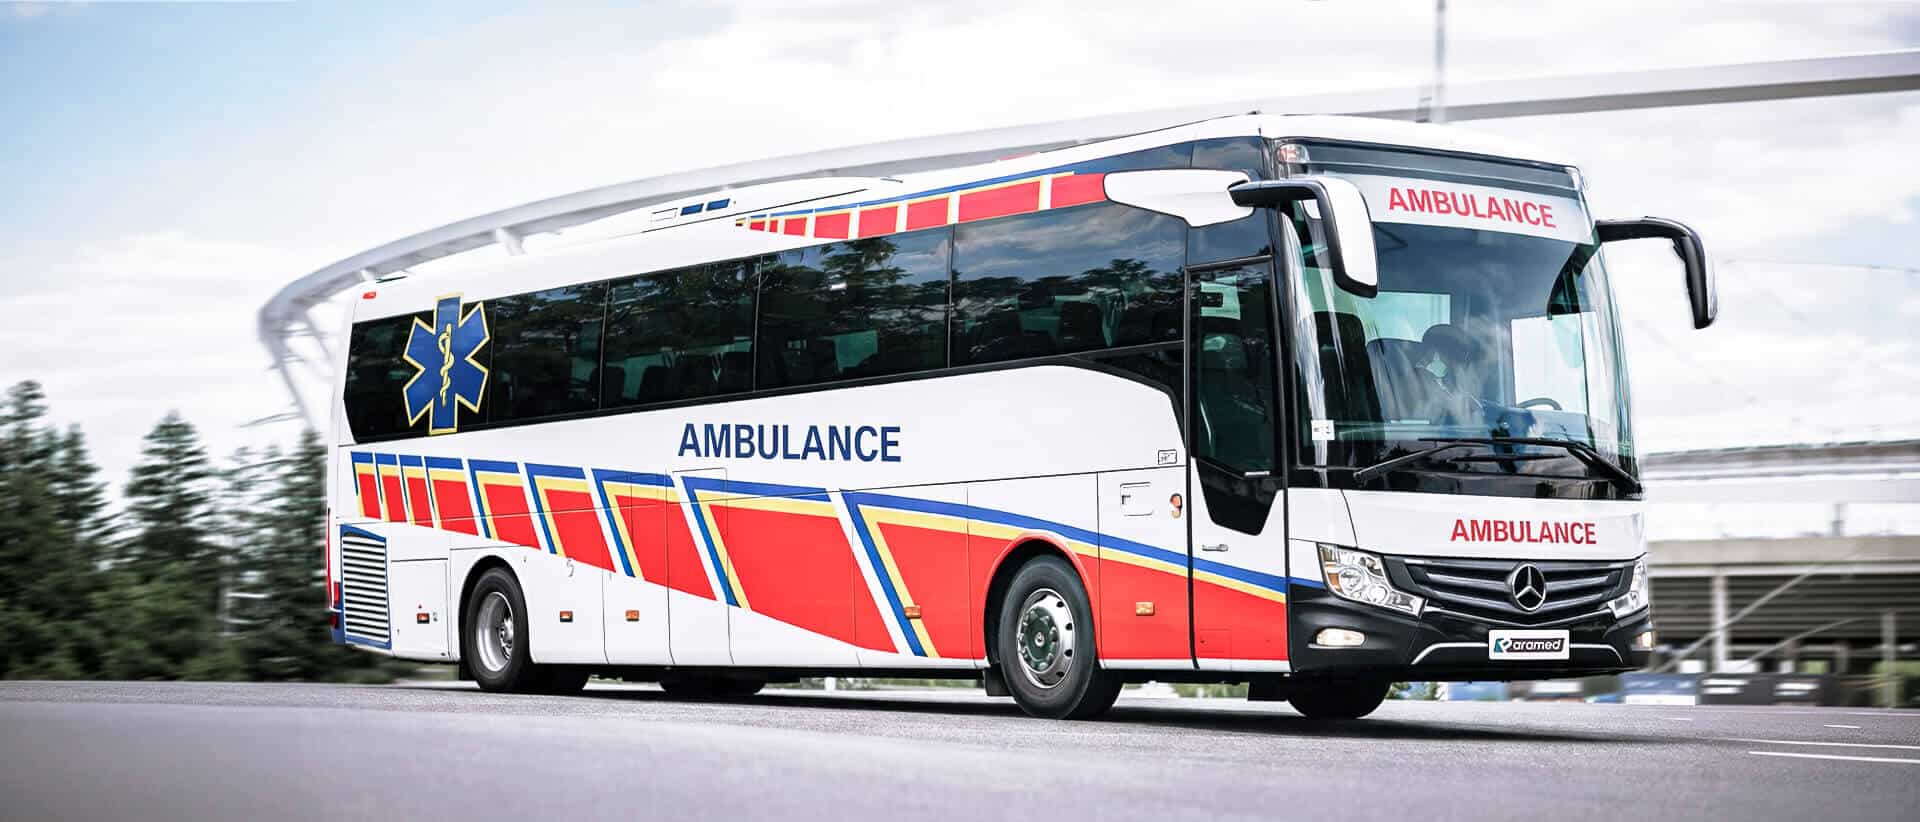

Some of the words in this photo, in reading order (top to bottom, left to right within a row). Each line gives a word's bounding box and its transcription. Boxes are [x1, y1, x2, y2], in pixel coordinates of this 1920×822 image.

[1388, 187, 1556, 228] AMBULANCE
[678, 423, 901, 462] AMBULANCE
[1450, 519, 1597, 545] AMBULANCE
